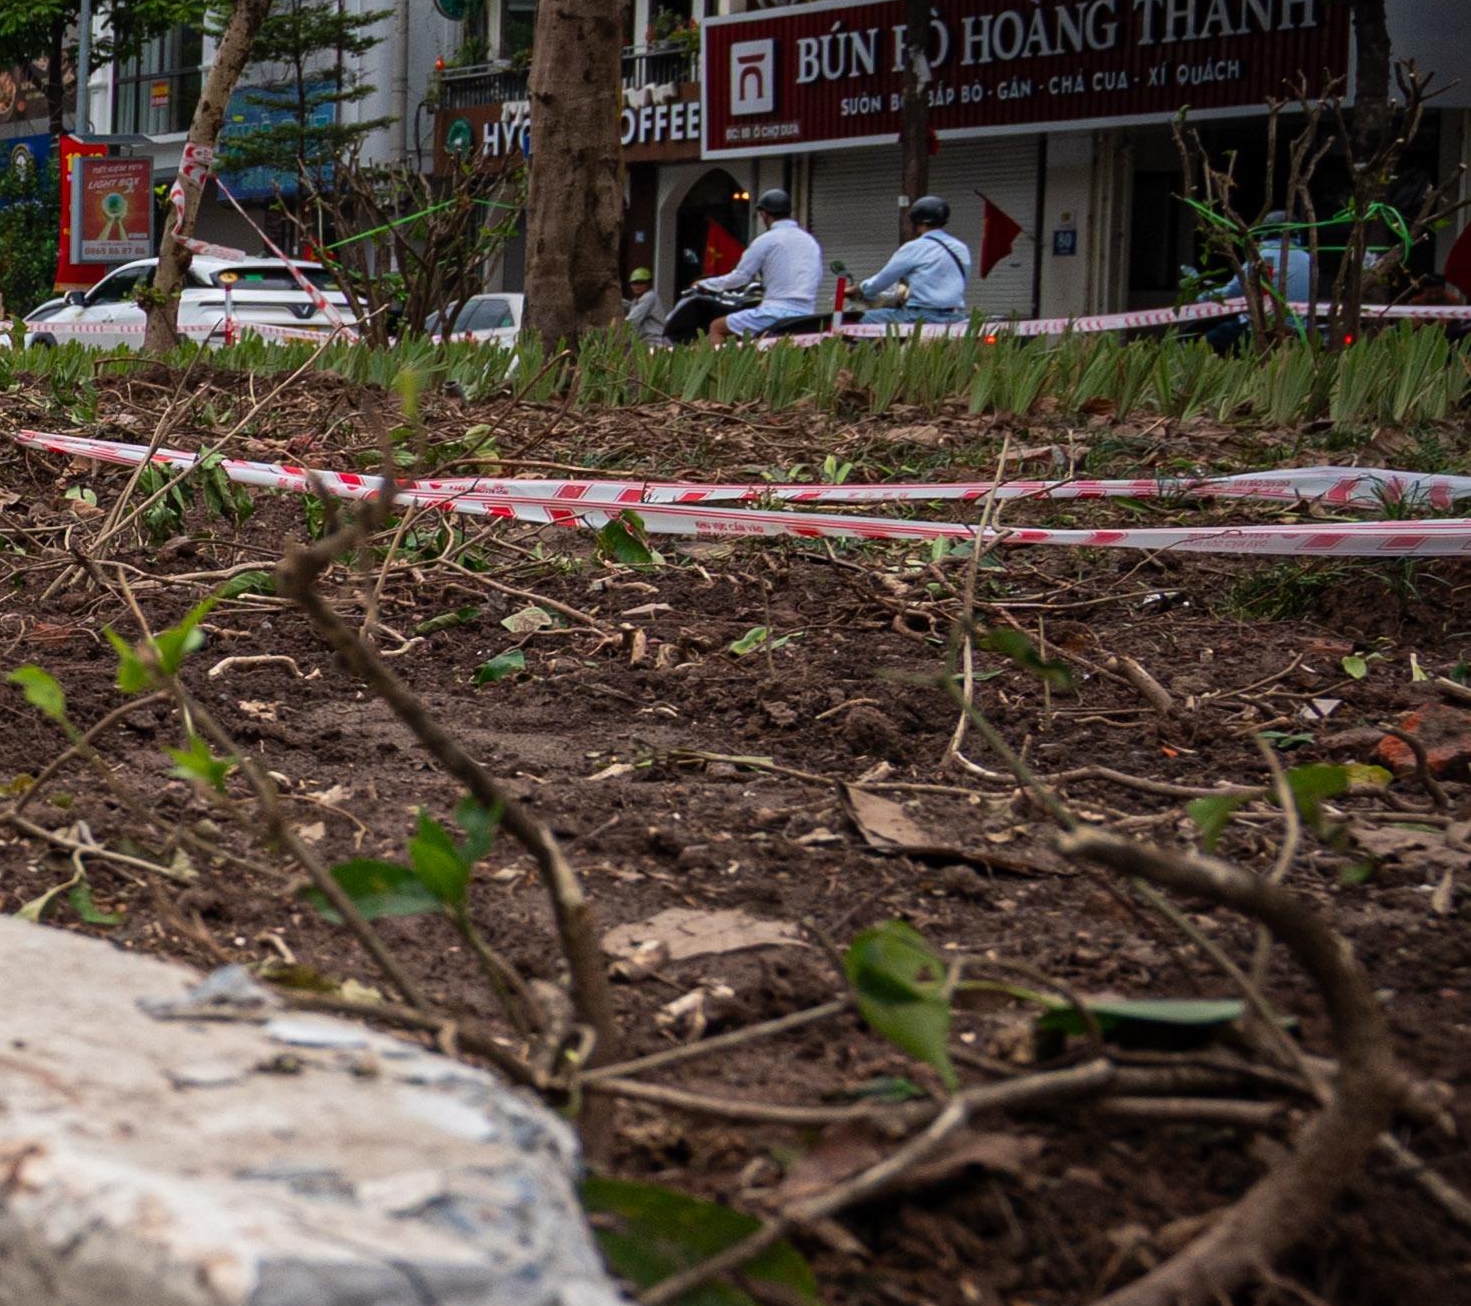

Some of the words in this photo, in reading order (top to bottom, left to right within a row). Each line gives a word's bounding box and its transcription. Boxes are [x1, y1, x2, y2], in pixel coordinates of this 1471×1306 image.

[796, 20, 879, 84] BÚN
[1092, 71, 1128, 93] CUA
[1176, 56, 1241, 86] QUÁCH
[620, 102, 700, 145] OFFEE
[88, 179, 118, 189] LIGHT
